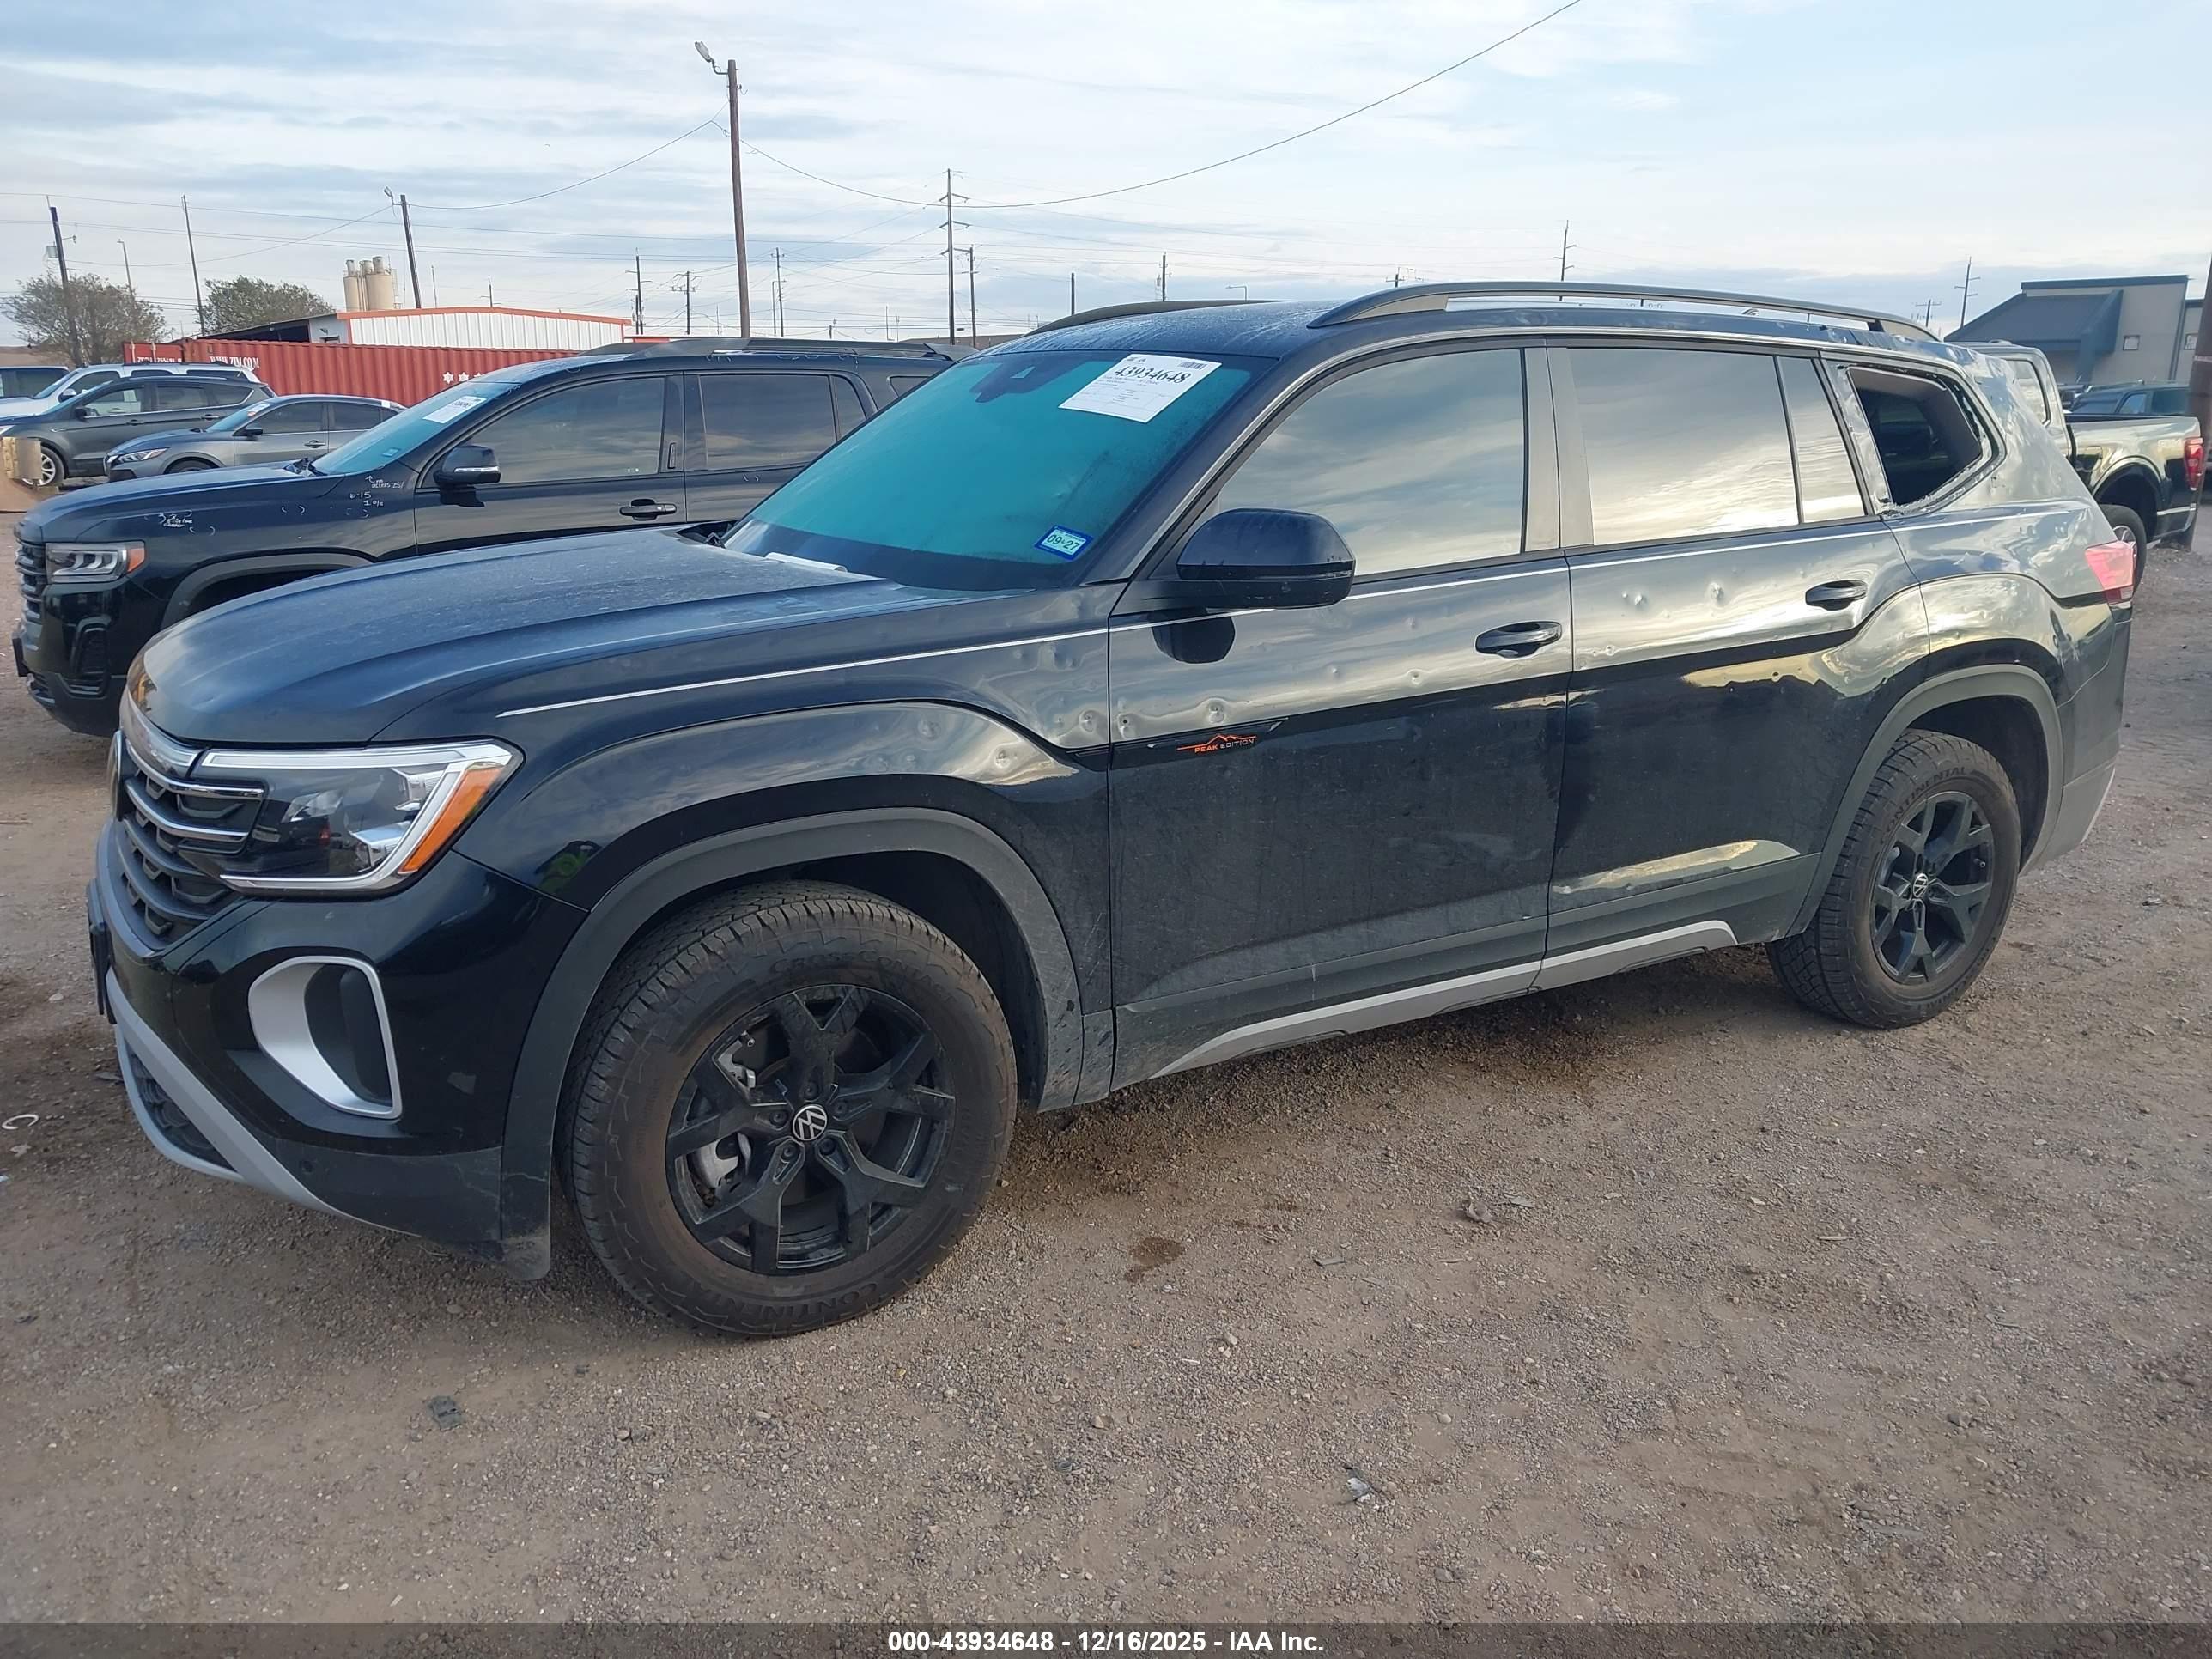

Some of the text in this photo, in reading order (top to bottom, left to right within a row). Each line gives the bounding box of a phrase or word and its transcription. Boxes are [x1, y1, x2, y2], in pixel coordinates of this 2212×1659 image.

[1115, 365, 1192, 384] 43934648
[1194, 738, 1255, 753] PEAK EDITION
